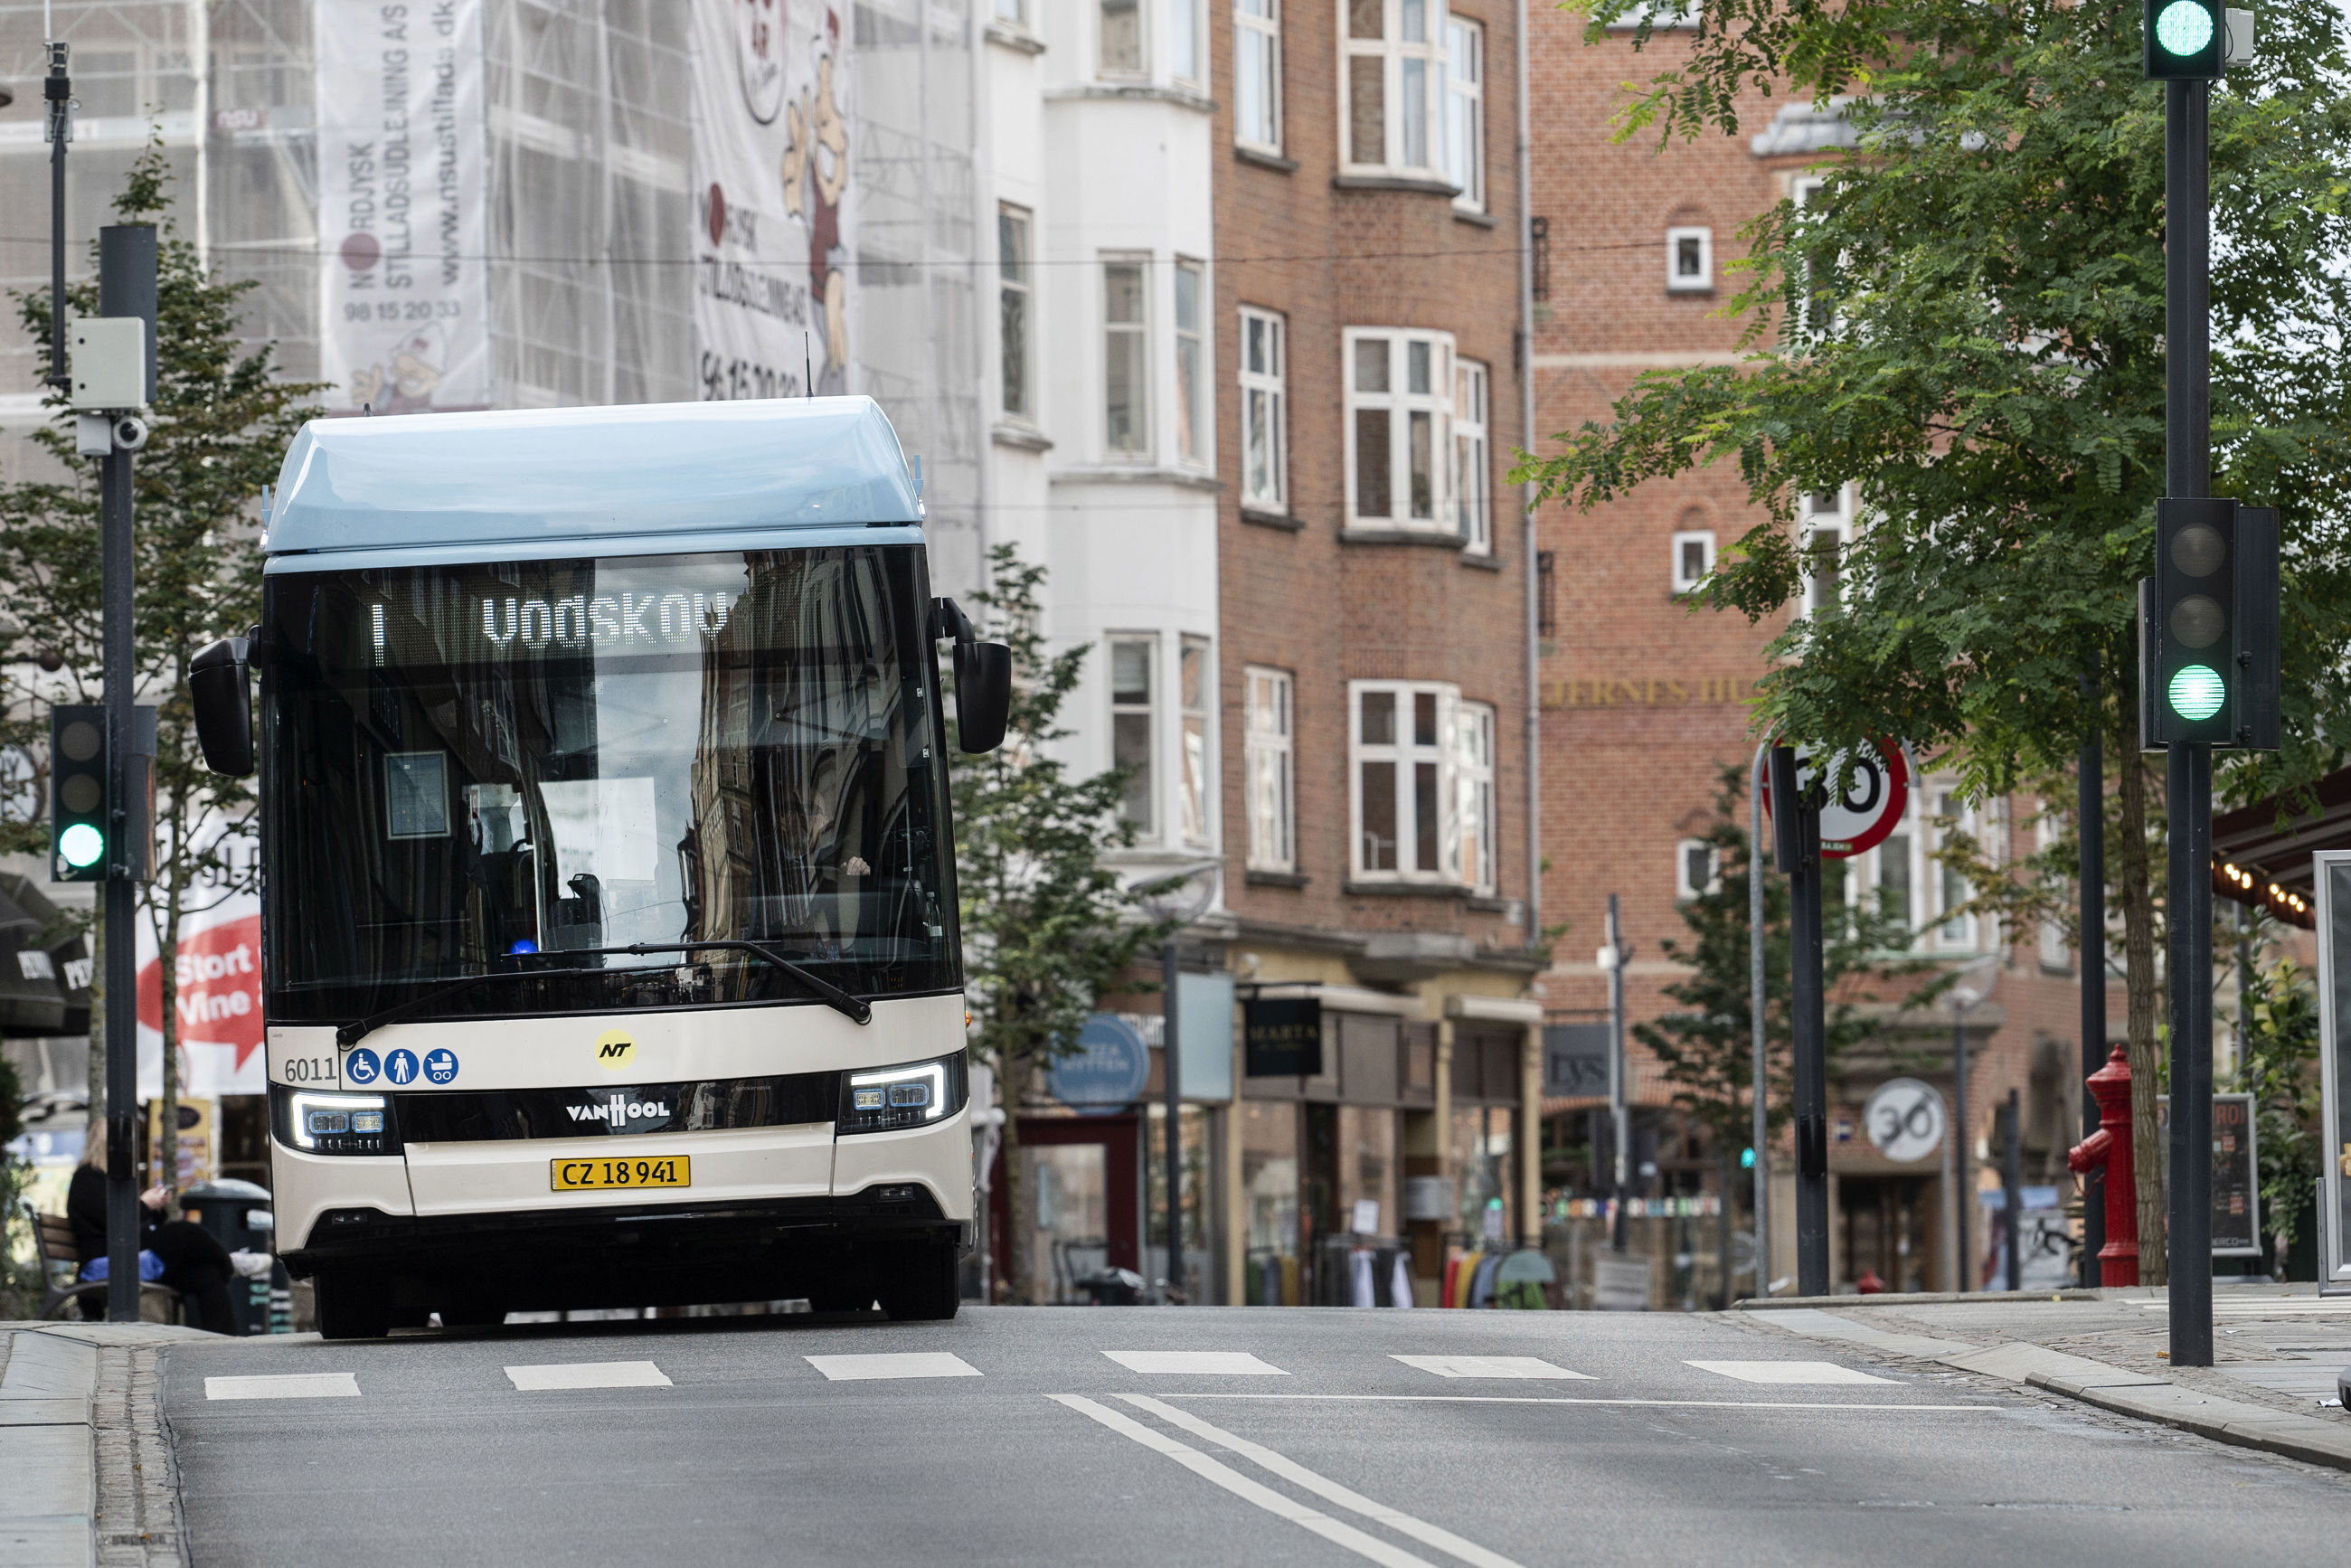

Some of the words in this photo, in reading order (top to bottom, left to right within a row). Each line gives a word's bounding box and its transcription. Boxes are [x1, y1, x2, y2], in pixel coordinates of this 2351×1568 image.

[381, 5, 407, 41] A/S
[175, 942, 254, 987] Stort
[599, 1043, 631, 1058] NT
[285, 1057, 337, 1082] 6011
[1877, 1104, 1933, 1140] 30
[562, 1163, 595, 1185] CZ
[603, 1161, 630, 1184] 18
[636, 1160, 678, 1184] 941
